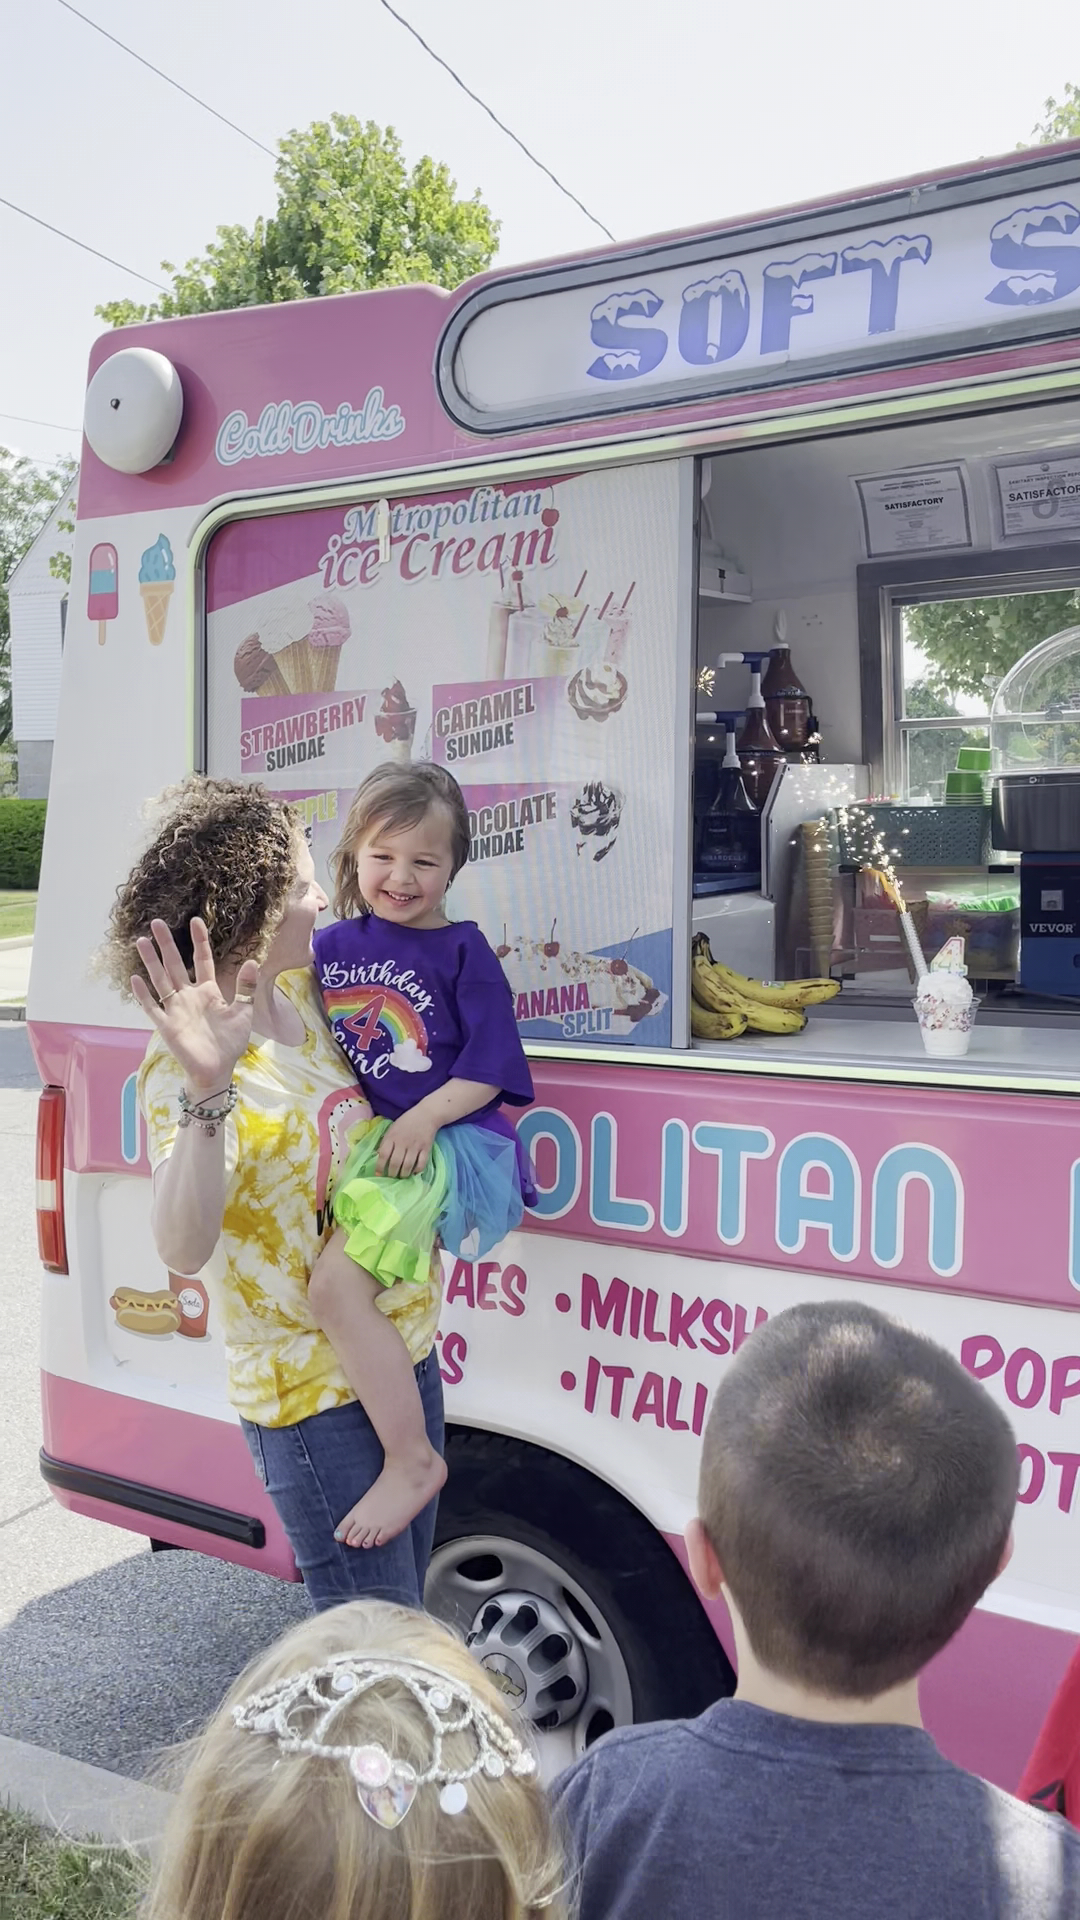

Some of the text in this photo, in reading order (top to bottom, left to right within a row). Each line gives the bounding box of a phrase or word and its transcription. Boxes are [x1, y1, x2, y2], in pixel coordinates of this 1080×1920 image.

[587, 235, 932, 381] SOFT
[217, 387, 404, 464] Cold Drinks
[341, 487, 542, 539] Mtropolitan
[884, 497, 944, 511] SATISFACTORY
[400, 527, 556, 581] Cream
[240, 696, 366, 758] STRAWBERRY
[436, 684, 535, 737] CARAMEL
[266, 735, 325, 772] SUNDAE
[446, 722, 514, 761] SUNDAE
[321, 959, 434, 1013] Birthday
[512, 982, 590, 1020] ANANA
[343, 994, 387, 1050] 4
[563, 1008, 613, 1037] SPLIT
